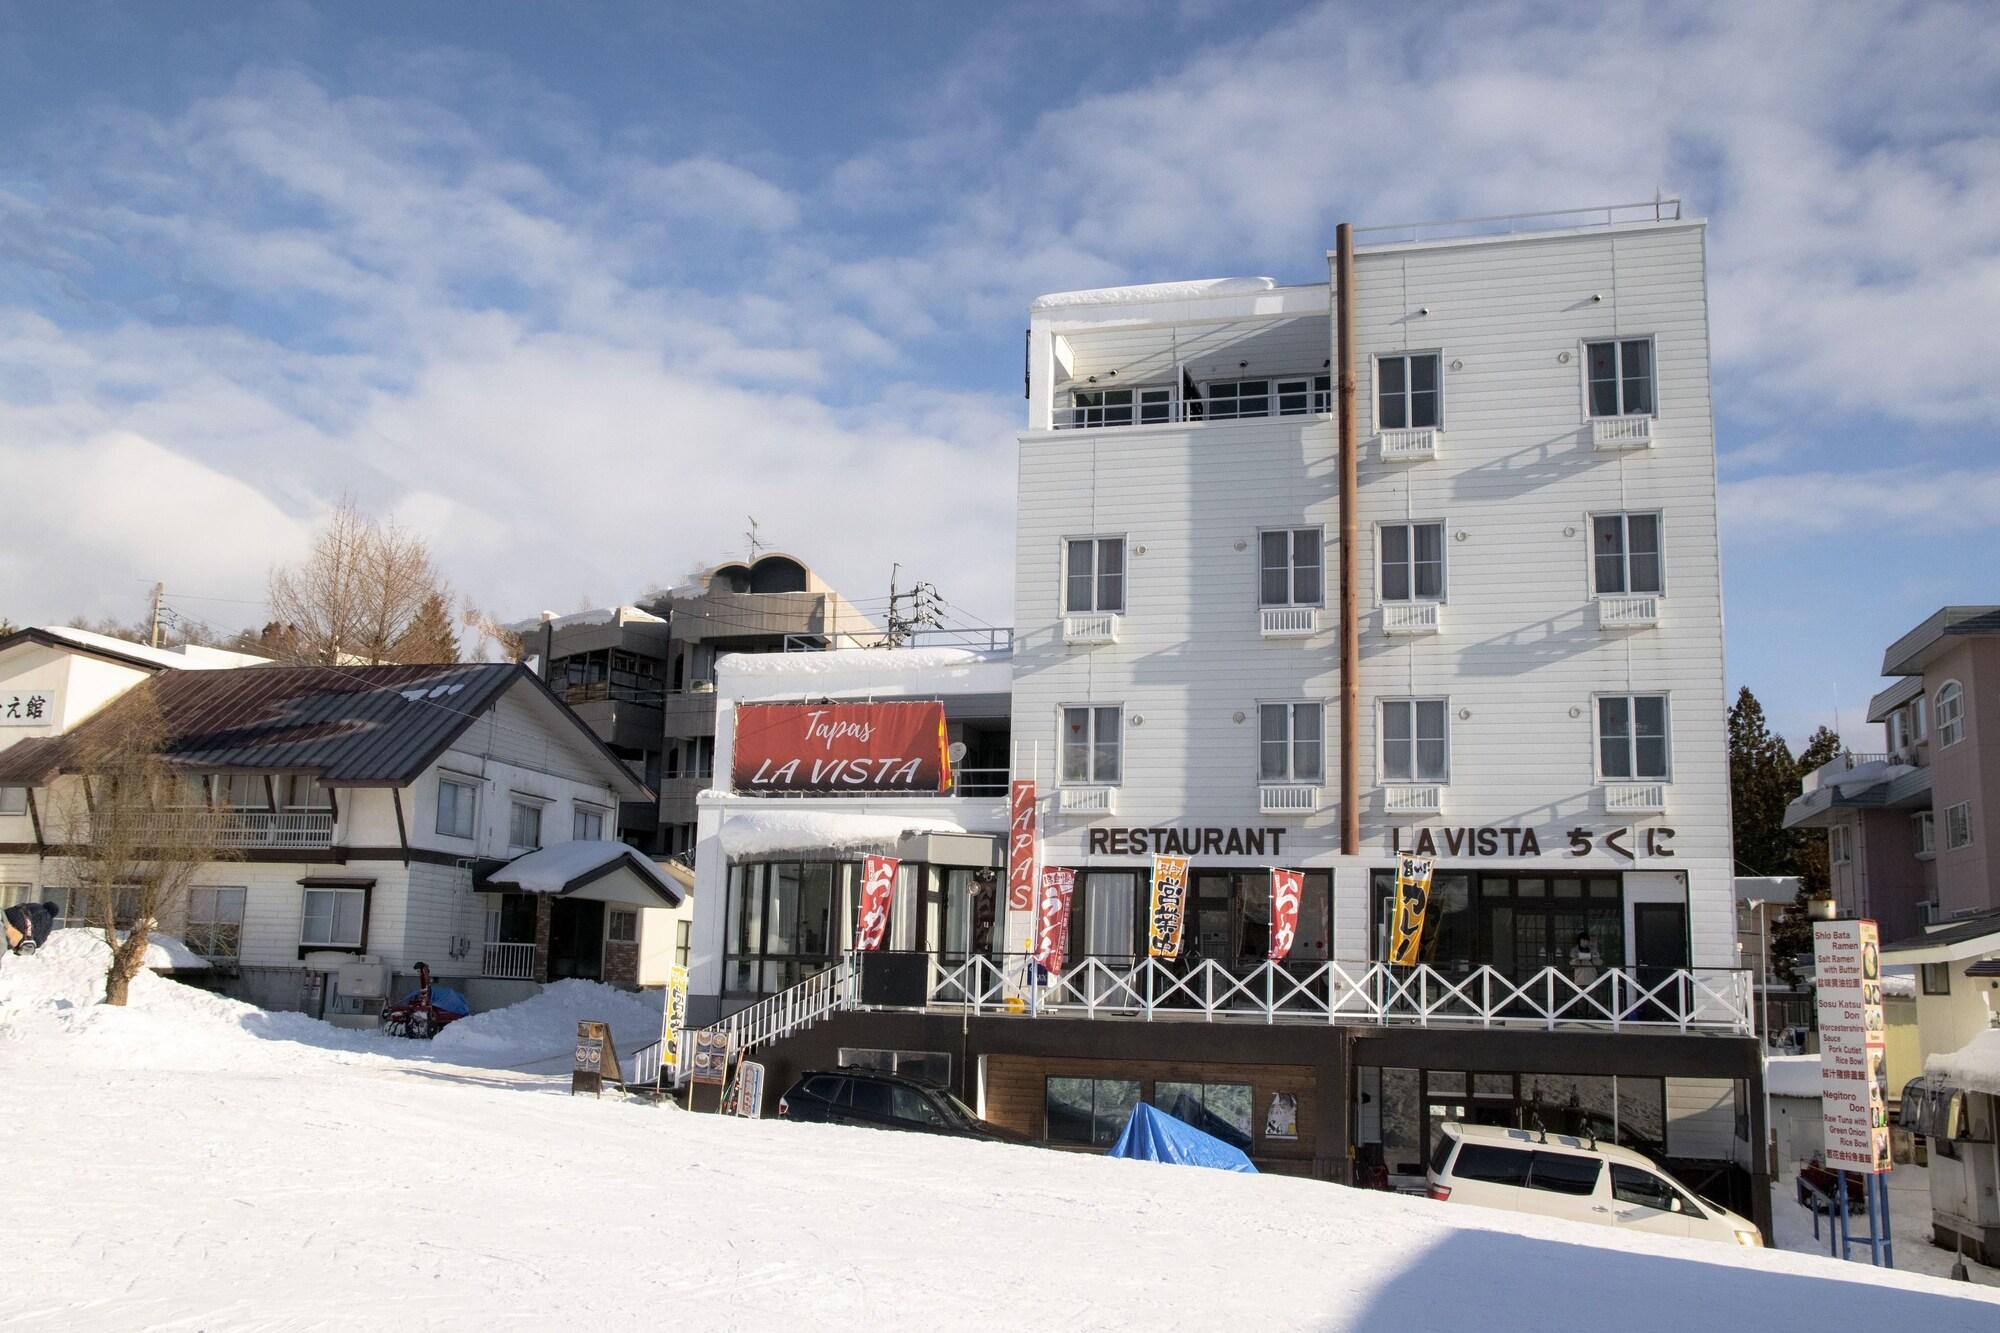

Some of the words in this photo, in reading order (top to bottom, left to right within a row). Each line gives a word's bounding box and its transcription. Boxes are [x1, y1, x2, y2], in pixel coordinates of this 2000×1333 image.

[0, 695, 46, 720] え館
[806, 711, 876, 750] Tapas
[752, 758, 802, 784] LA
[811, 757, 923, 785] VISTA
[1089, 828, 1286, 855] RESTAURANT
[1392, 827, 1437, 856] LA
[1443, 827, 1541, 857] VISTA
[1567, 826, 1676, 860] ちくに
[1010, 784, 1034, 910] TAPAS
[1815, 931, 1832, 940] Shio
[1833, 931, 1851, 940] Bata
[1832, 942, 1859, 950] Ramen
[1832, 955, 1855, 963] Ramen
[1824, 966, 1838, 974] with
[1839, 966, 1860, 974] Butter
[1818, 1000, 1837, 1008] Sosu
[1838, 1000, 1861, 1009] Katsu
[1844, 1011, 1860, 1020] Don
[1820, 1023, 1864, 1033] Worcestershire
[1823, 1034, 1841, 1042] Sauce
[1828, 1044, 1844, 1054] Pork
[1836, 1056, 1849, 1065] Rice
[1850, 1057, 1864, 1066] Bowl
[1823, 1090, 1857, 1102] Negitoro
[1849, 1103, 1866, 1113] Don
[1829, 1125, 1847, 1135] Green
[1848, 1127, 1867, 1137] Onion
[1854, 1138, 1869, 1148] Bowl
